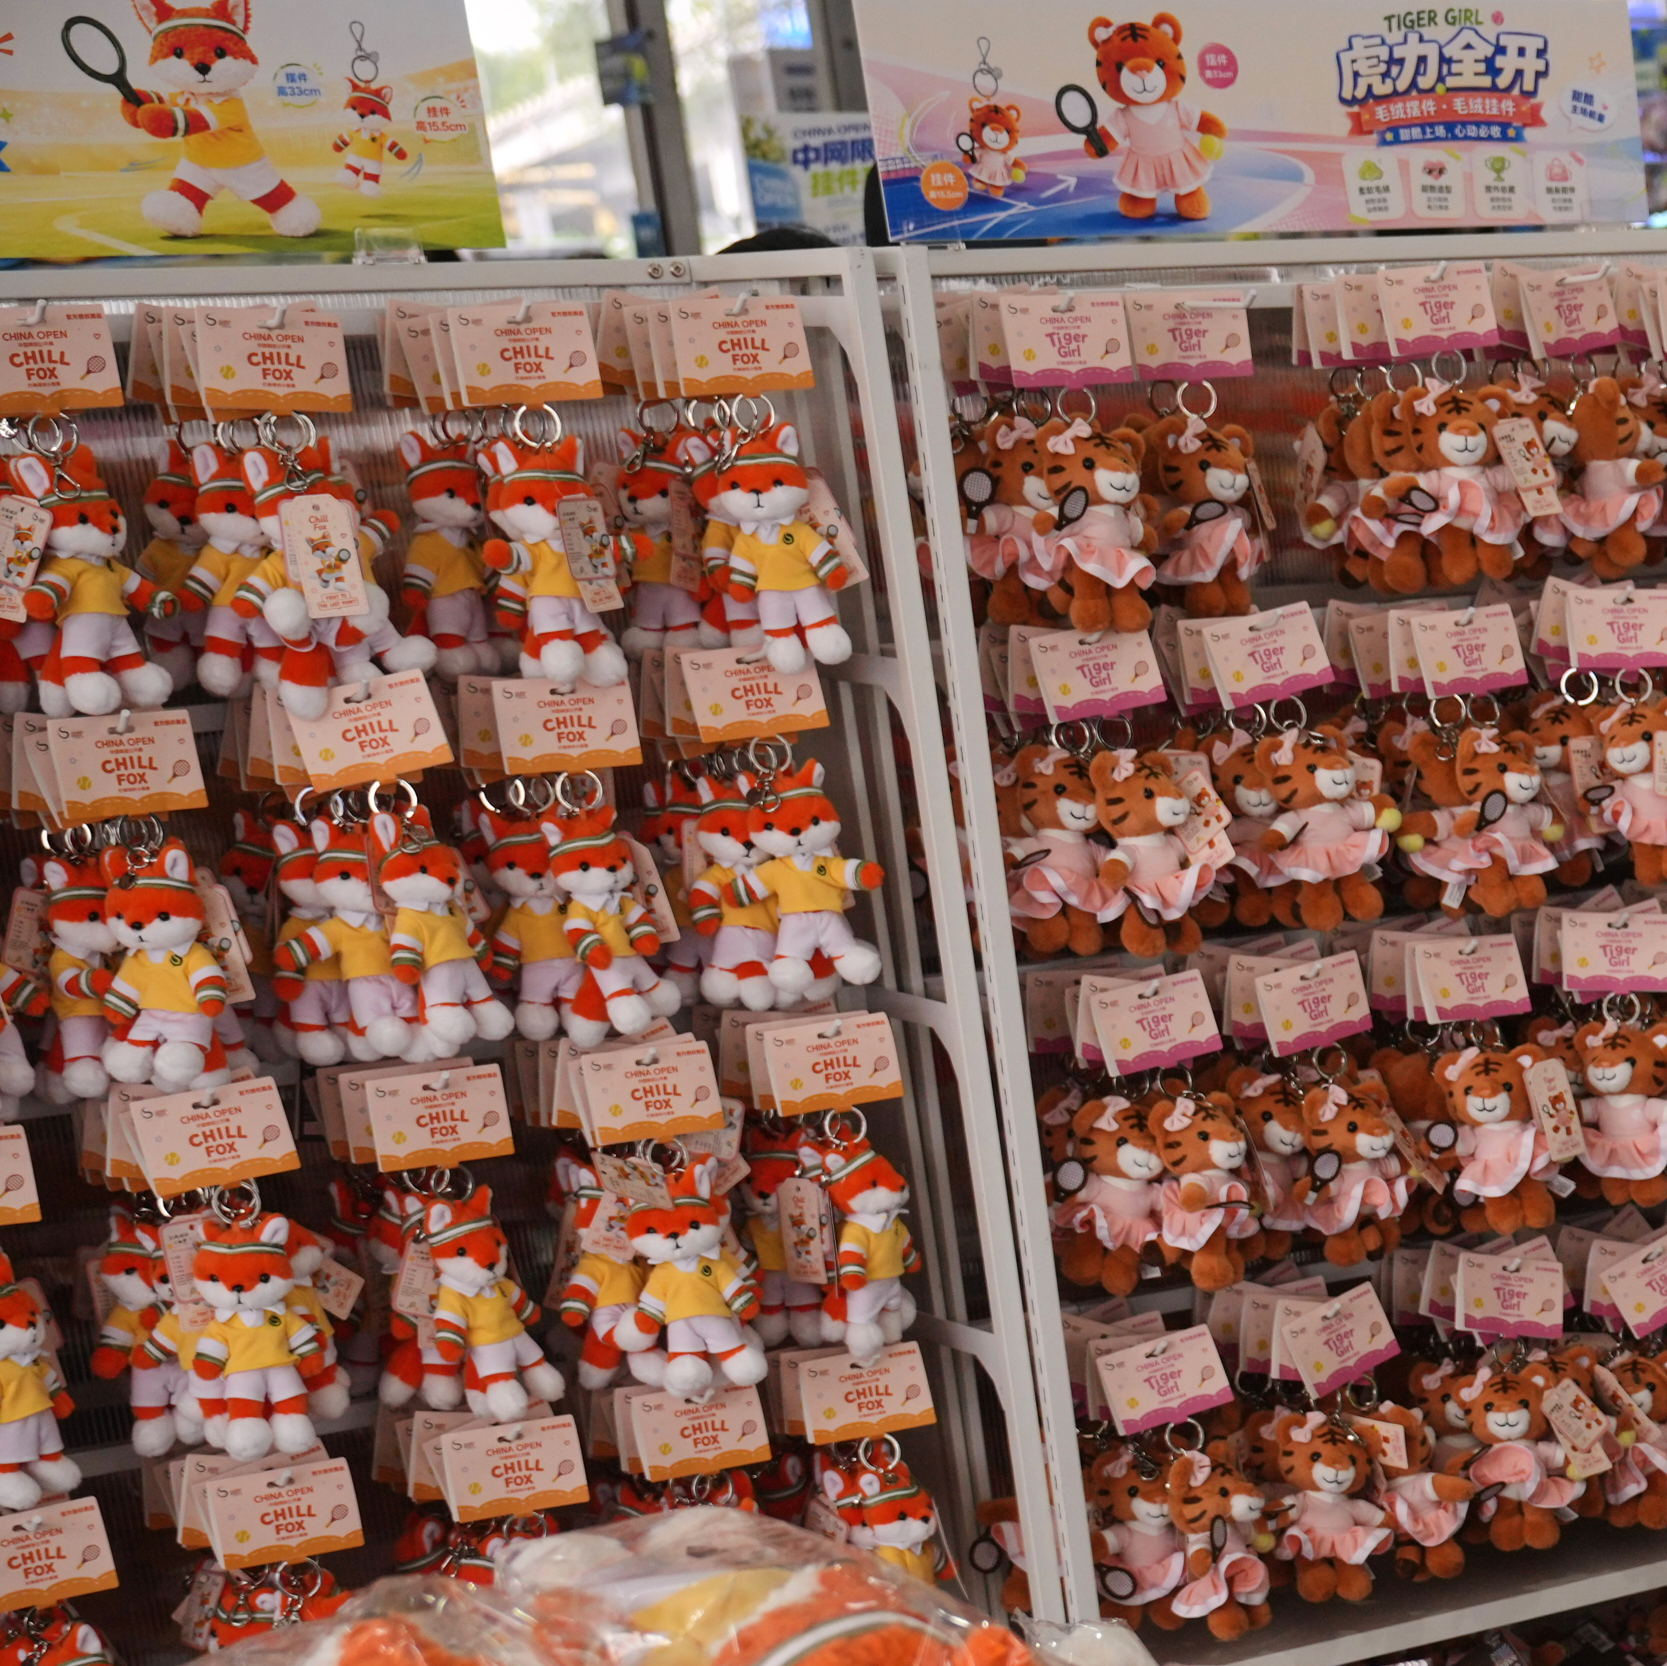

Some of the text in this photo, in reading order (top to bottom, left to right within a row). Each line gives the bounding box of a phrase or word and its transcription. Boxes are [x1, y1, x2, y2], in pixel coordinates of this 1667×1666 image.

[1384, 10, 1438, 33] TIGER
[1337, 26, 1549, 106] 虎力全开
[277, 86, 321, 97] 高33cm
[427, 106, 451, 118] 挂件
[416, 121, 467, 132] 高15.5cm
[930, 173, 957, 187] 挂件
[1413, 284, 1458, 294] CHINA OPEN
[1419, 300, 1456, 315] Tiger
[1040, 316, 1065, 324] CHINA
[1163, 311, 1213, 321] CHINA OPEN
[1430, 312, 1450, 324] Girl
[494, 326, 552, 337] CHINA OPEN
[712, 319, 767, 330] CHINA OPEN
[2, 330, 68, 342] CHINA OPEN
[242, 332, 304, 343] CHINA OPEN
[1045, 331, 1088, 348] Tiger
[1167, 328, 1209, 344] Tiger
[500, 344, 554, 361] CHILL
[718, 337, 770, 353] CHILL
[1058, 344, 1081, 358] Girl
[1179, 339, 1202, 352] Girl
[9, 349, 70, 367] CHILL
[247, 351, 306, 370] CHILL
[732, 352, 760, 365] FOX
[26, 367, 58, 380] FOX
[262, 368, 294, 381] FOX
[514, 362, 544, 374] FOX
[309, 515, 328, 524] Chill
[1607, 621, 1644, 637] Tiger
[1240, 629, 1286, 646] CHINA OPEN
[1617, 633, 1638, 644] Girl
[1069, 643, 1118, 658] CHINA OPEN
[1247, 645, 1285, 665] Tiger
[1076, 660, 1117, 679] Tiger
[1261, 658, 1283, 673] Girl
[1089, 674, 1112, 688] Girl
[332, 699, 393, 721] CHINA OPEN
[537, 697, 594, 709] CHINA OPEN
[341, 719, 399, 742] CHILL
[542, 714, 597, 732] CHILL
[95, 736, 155, 749] CHINA OPEN
[359, 735, 391, 752] FOX
[557, 731, 587, 744] FOX
[101, 756, 158, 774] CHILL
[116, 772, 148, 786] FOX
[1620, 931, 1644, 939] OPEN
[1599, 945, 1639, 960] Tiger
[1609, 956, 1630, 967] Girl
[1129, 996, 1176, 1013] CHINA OPEN
[1136, 1013, 1174, 1032] Tiger
[1148, 1028, 1171, 1041] Girl
[806, 1038, 859, 1052] CHINA OPEN
[811, 1055, 861, 1074] CHILL
[624, 1066, 678, 1079] CHINA OPEN
[824, 1070, 852, 1084] FOX
[410, 1090, 467, 1105] CHINA OPEN
[631, 1084, 682, 1101] CHILL
[644, 1098, 673, 1111] FOX
[180, 1106, 242, 1124] CHINA OPEN
[416, 1109, 470, 1128] CHILL
[188, 1125, 247, 1147] CHILL
[430, 1125, 459, 1138] FOX
[205, 1142, 238, 1157] FOX
[1136, 1353, 1184, 1372] CHINA OPEN
[1144, 1370, 1183, 1390] Tiger
[1157, 1383, 1180, 1397] Girl
[486, 1441, 542, 1457] CHINA OPEN
[491, 1459, 544, 1478] CHILL
[505, 1474, 534, 1488] FOX
[254, 1486, 314, 1503] CHINA OPEN
[260, 1504, 317, 1525] CHILL
[275, 1520, 306, 1535] FOX
[0, 1528, 63, 1548] CHINA OPEN
[7, 1546, 67, 1569] CHILL
[23, 1562, 57, 1579] FOX
